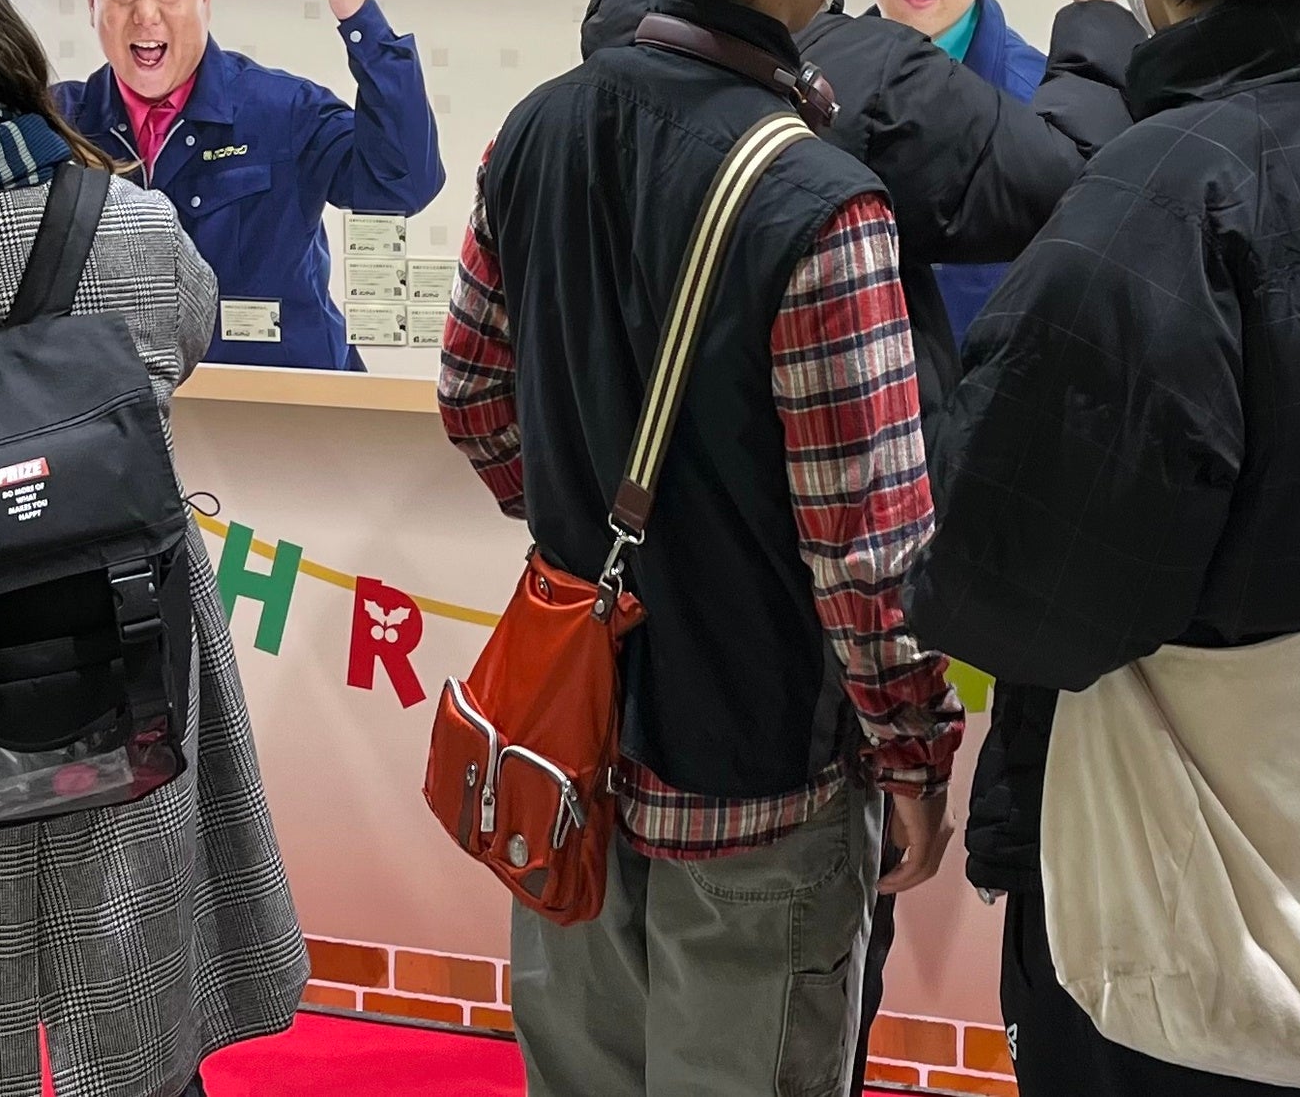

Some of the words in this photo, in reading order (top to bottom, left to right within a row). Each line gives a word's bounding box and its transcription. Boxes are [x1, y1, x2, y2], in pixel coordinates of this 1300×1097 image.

[14, 485, 35, 496] MORE
[35, 482, 45, 491] OF
[15, 493, 37, 505] WHAT
[8, 503, 32, 515] MAKES
[32, 499, 48, 509] YOU
[18, 509, 42, 521] HAPPY
